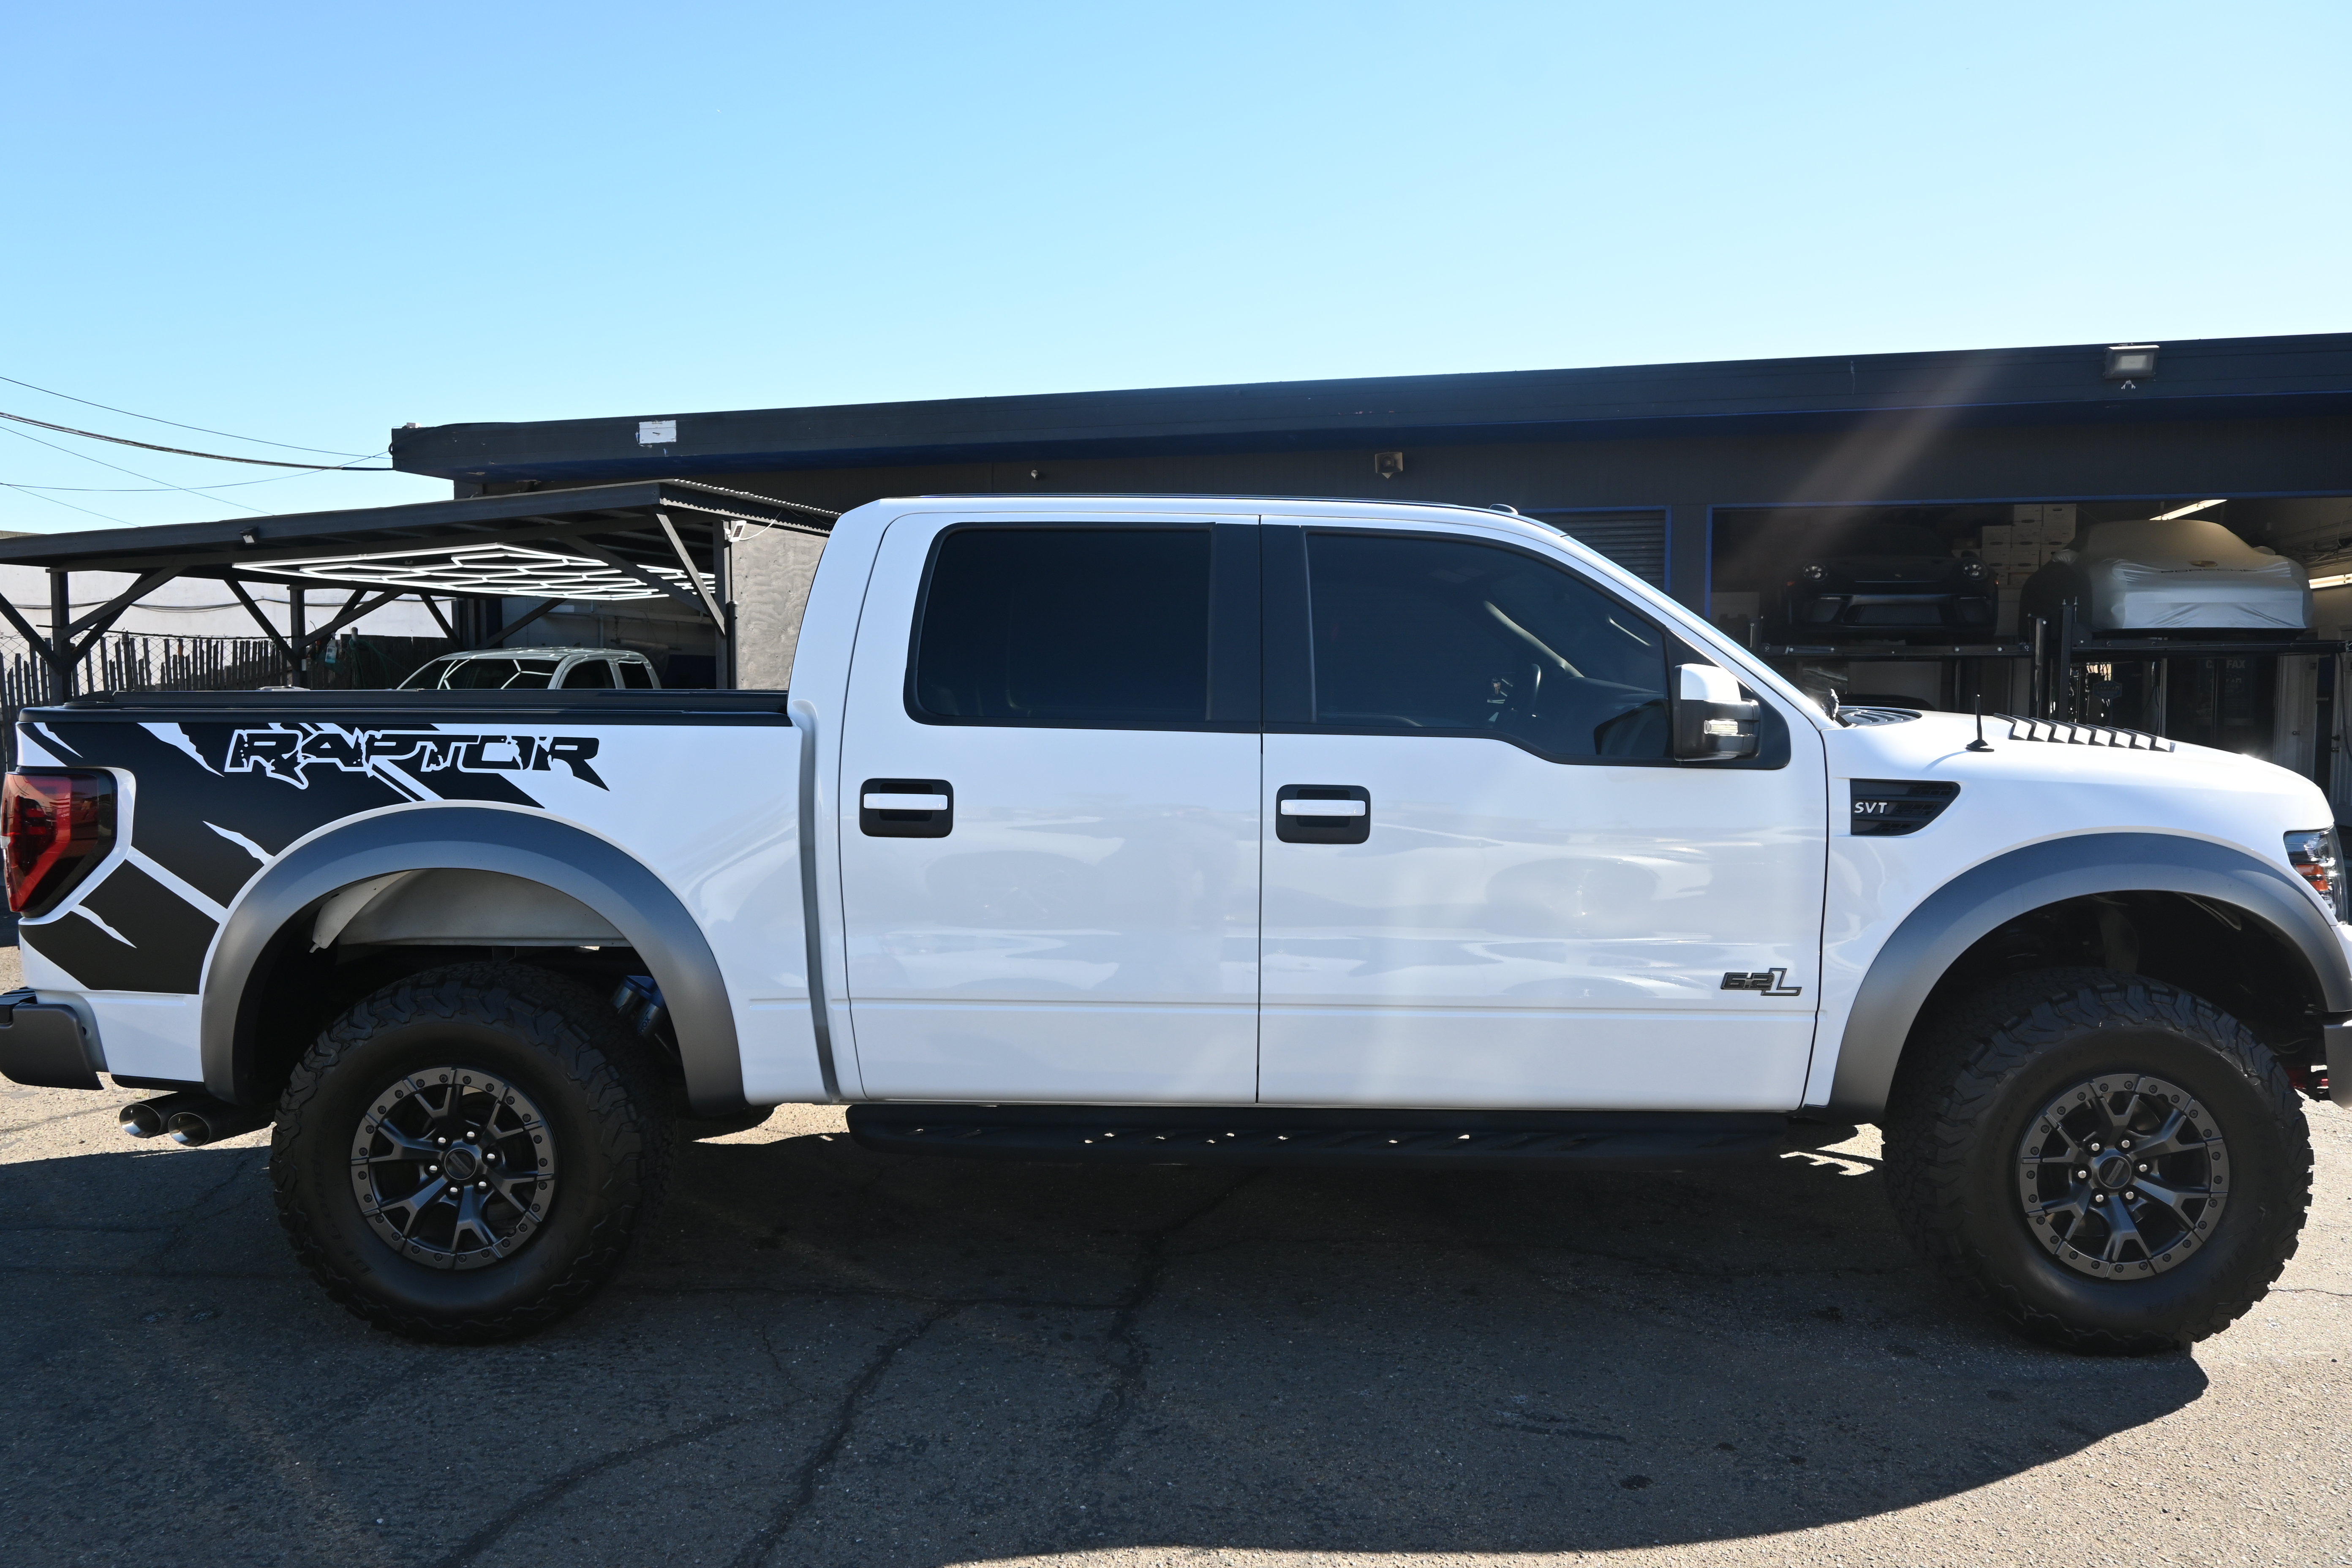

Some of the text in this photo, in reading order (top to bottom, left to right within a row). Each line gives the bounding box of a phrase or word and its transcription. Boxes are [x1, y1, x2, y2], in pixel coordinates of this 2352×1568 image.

[2205, 660, 2246, 668] CFAX
[224, 728, 611, 791] RAPTOR
[1854, 802, 1888, 814] SVT
